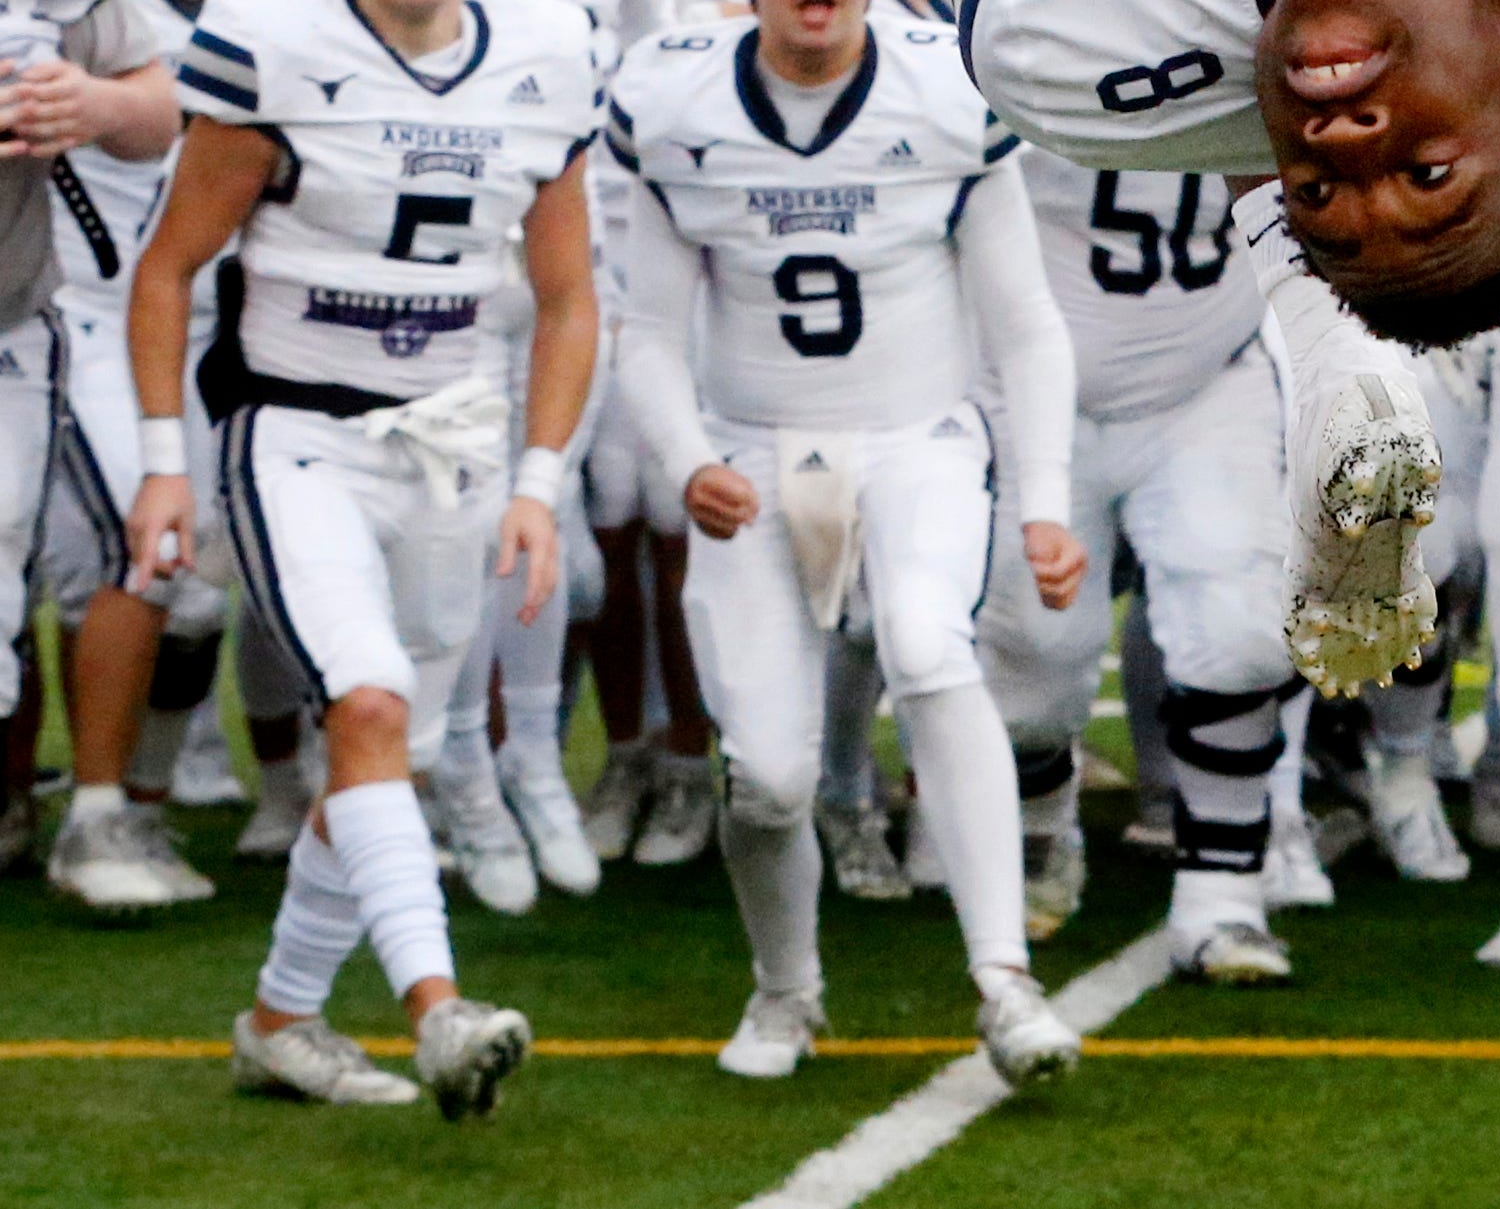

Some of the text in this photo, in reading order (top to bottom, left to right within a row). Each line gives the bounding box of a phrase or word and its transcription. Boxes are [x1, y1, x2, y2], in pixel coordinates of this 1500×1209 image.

[1096, 48, 1224, 113] 8
[382, 126, 503, 149] ANDERSON
[747, 187, 875, 210] ANDERSON
[771, 253, 863, 357] 9
